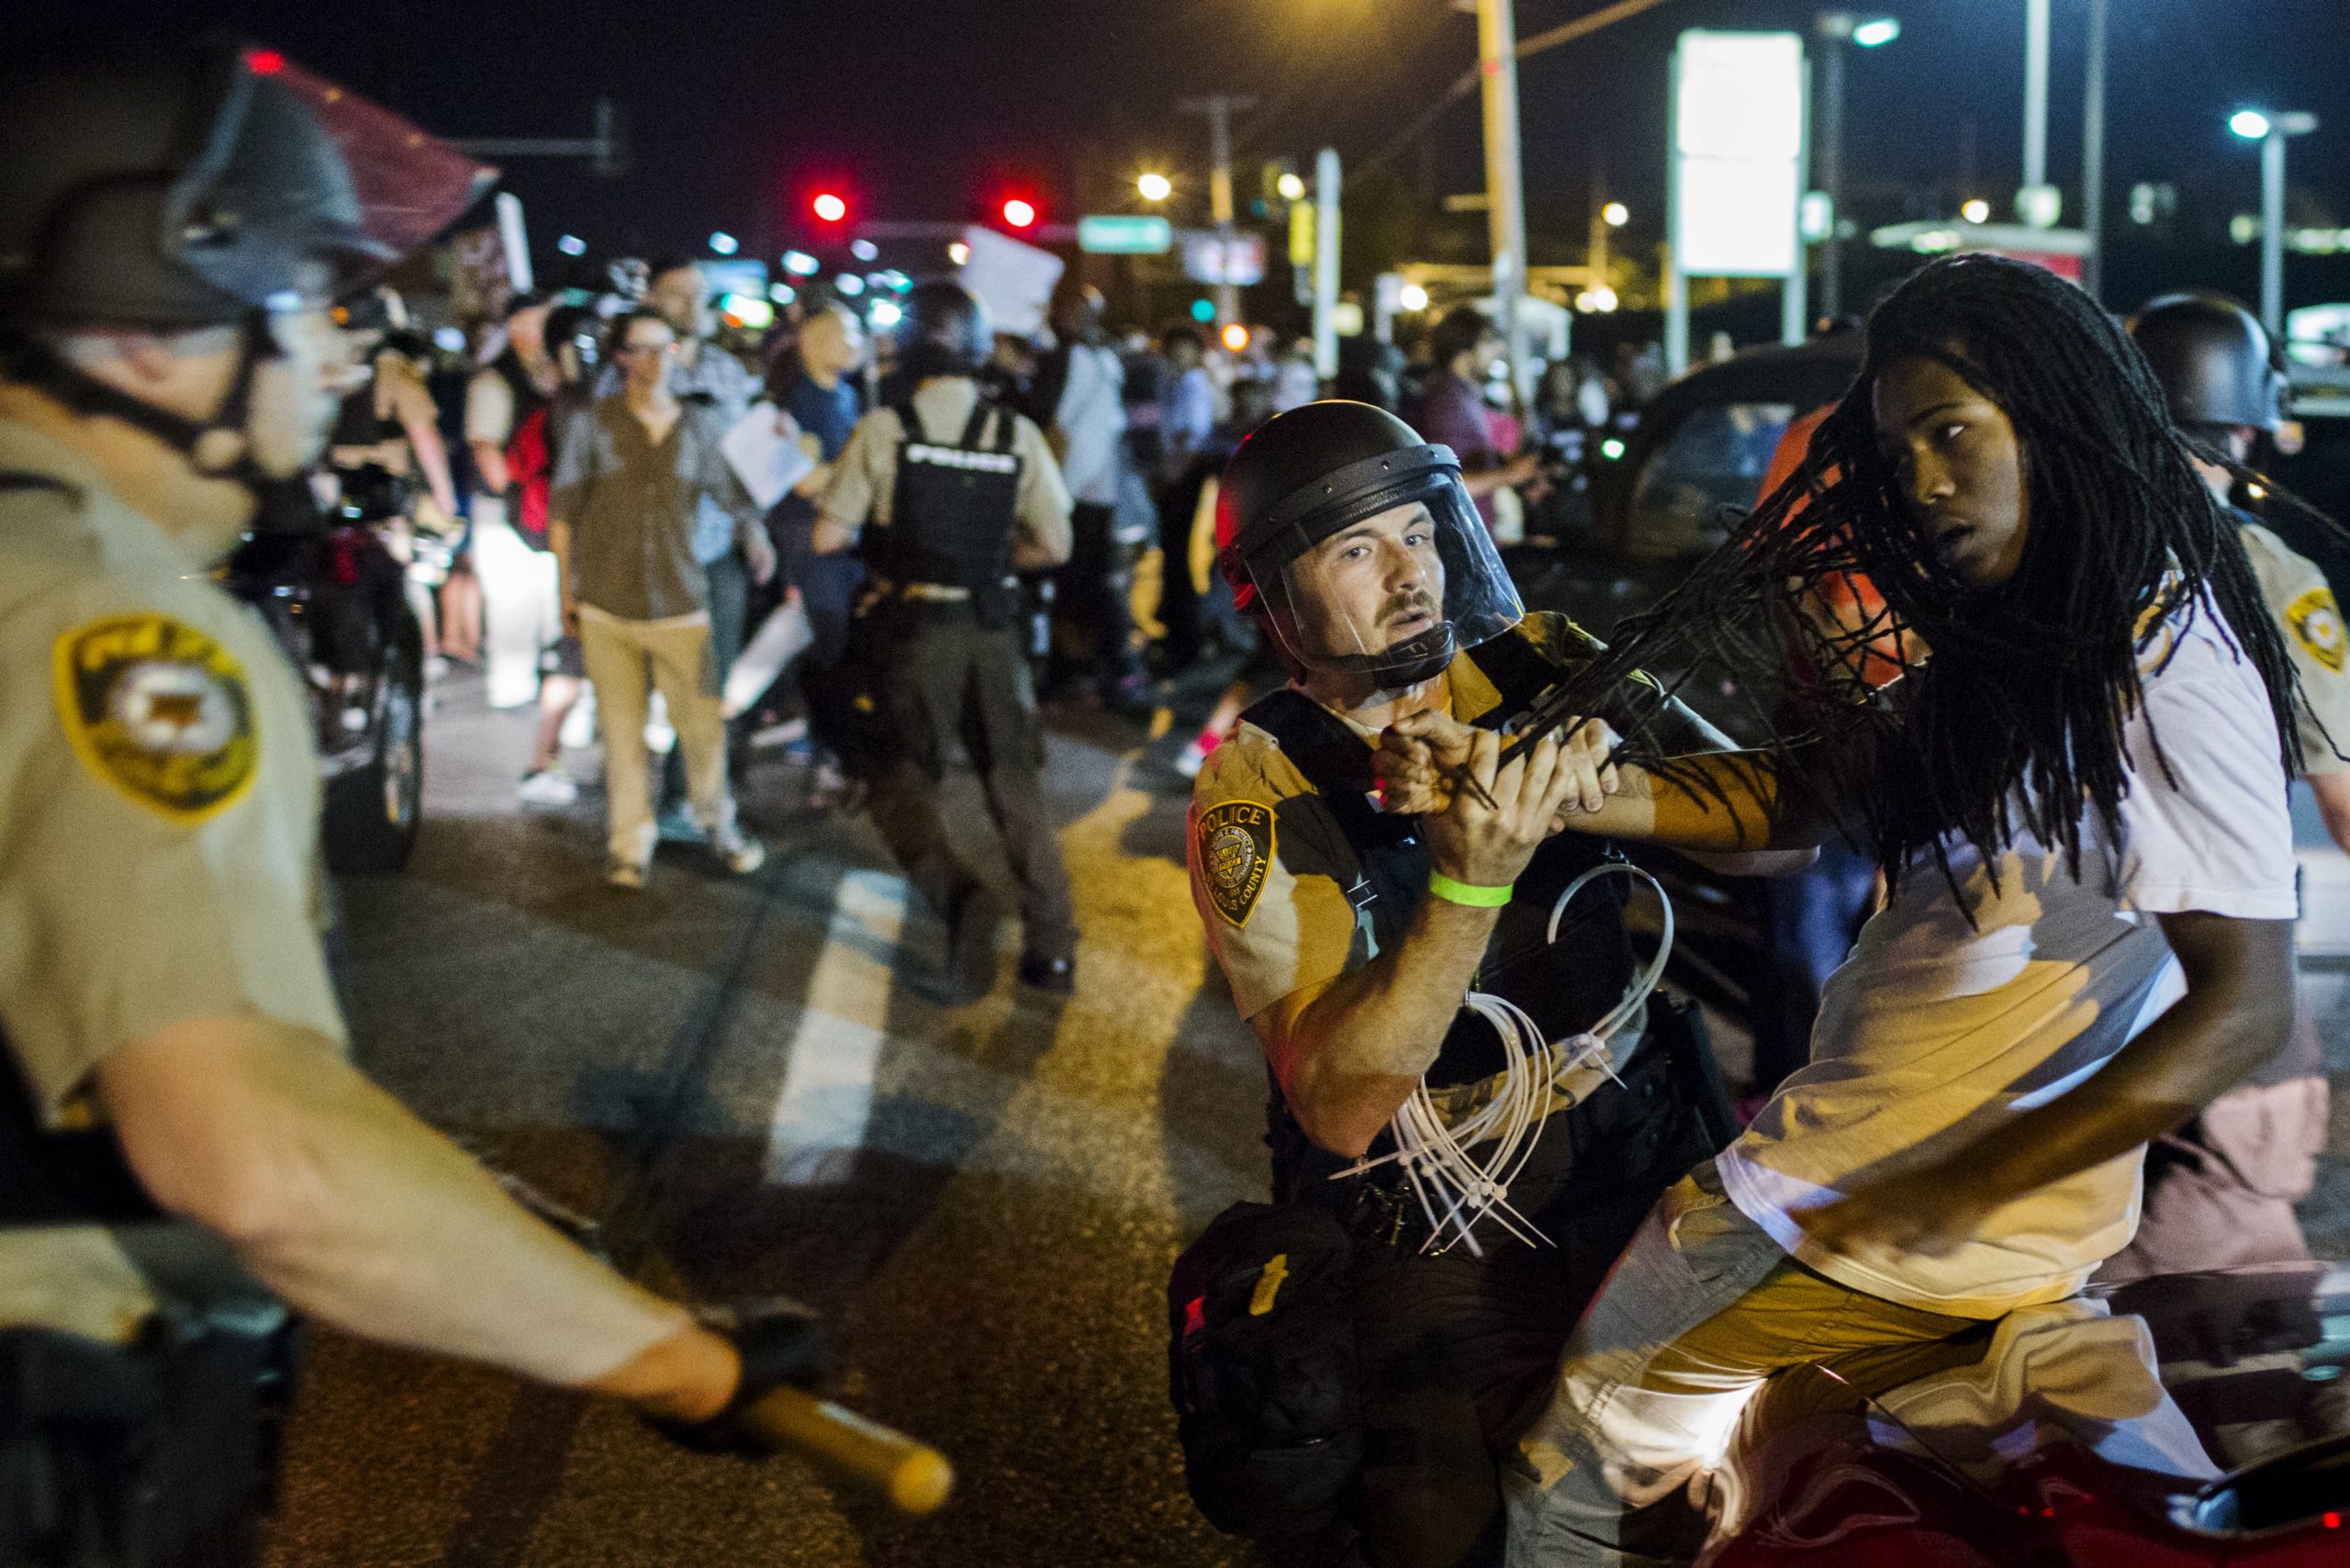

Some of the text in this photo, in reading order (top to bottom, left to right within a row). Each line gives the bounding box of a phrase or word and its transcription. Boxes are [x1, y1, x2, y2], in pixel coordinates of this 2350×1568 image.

[1200, 806, 1264, 841] POLICE
[1213, 888, 1238, 911] LOUIS
[1239, 856, 1267, 905] COUNTY
